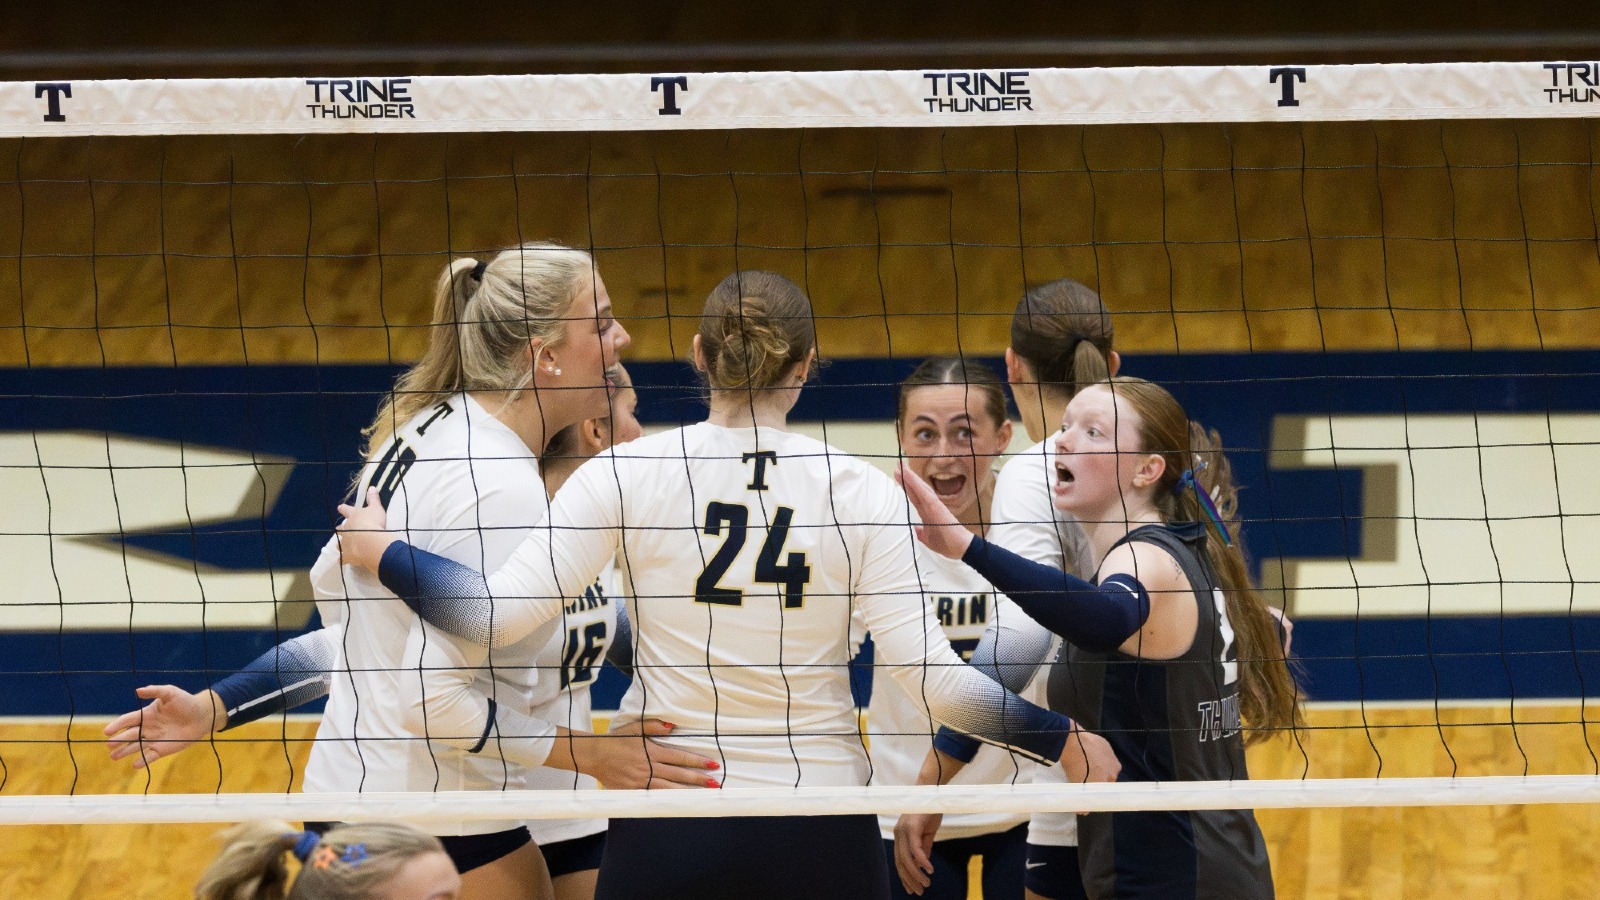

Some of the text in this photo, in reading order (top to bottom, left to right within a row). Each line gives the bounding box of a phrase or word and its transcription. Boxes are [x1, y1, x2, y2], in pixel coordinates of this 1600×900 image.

[306, 79, 411, 103] TRINE
[923, 71, 1030, 96] TRINE
[1269, 67, 1306, 107] T
[1543, 63, 1600, 87] TRI
[35, 83, 72, 122] T
[306, 104, 416, 119] THUNDER
[651, 76, 688, 115] T
[924, 97, 1034, 112] THUNDER
[416, 401, 454, 437] T
[742, 450, 777, 490] T
[694, 500, 811, 608] 24
[931, 594, 986, 626] RIN
[560, 621, 607, 690] 16
